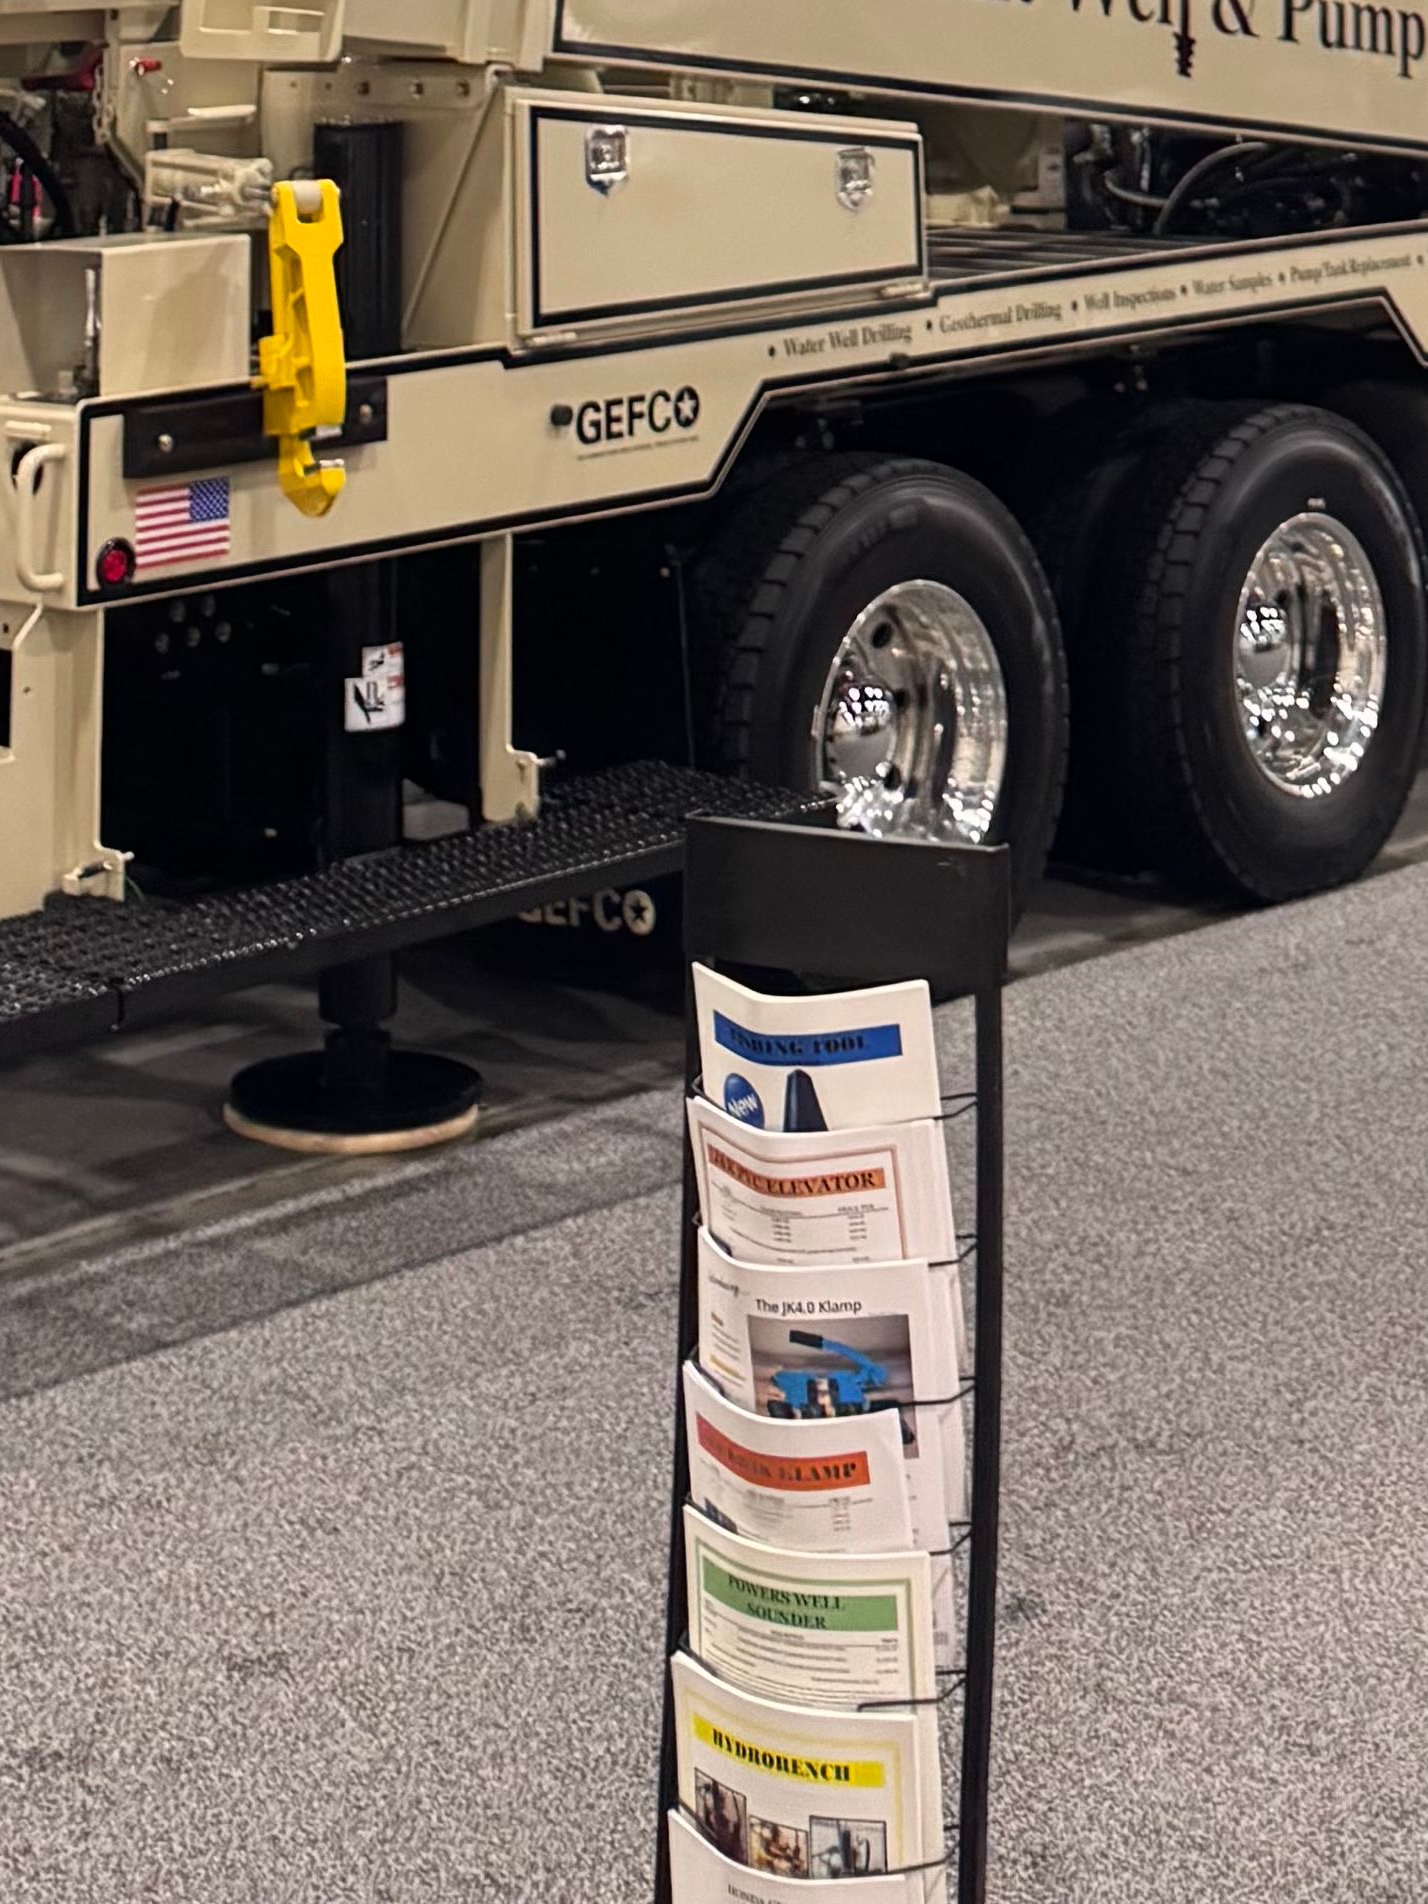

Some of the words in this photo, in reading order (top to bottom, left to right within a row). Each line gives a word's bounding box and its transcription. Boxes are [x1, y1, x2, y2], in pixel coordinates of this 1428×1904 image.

[1016, 301, 1063, 324] Drilling
[783, 336, 825, 357] Water
[828, 329, 858, 349] Well
[862, 322, 912, 347] Drilling
[575, 385, 700, 444] GEFCO
[727, 1093, 759, 1119] New
[766, 1172, 876, 1197] ELEVATOR
[756, 1298, 780, 1314] The
[818, 1298, 863, 1315] Klamp
[728, 1573, 791, 1606] POWERS
[792, 1593, 847, 1611] WELL
[746, 1602, 828, 1630] SOUNDER
